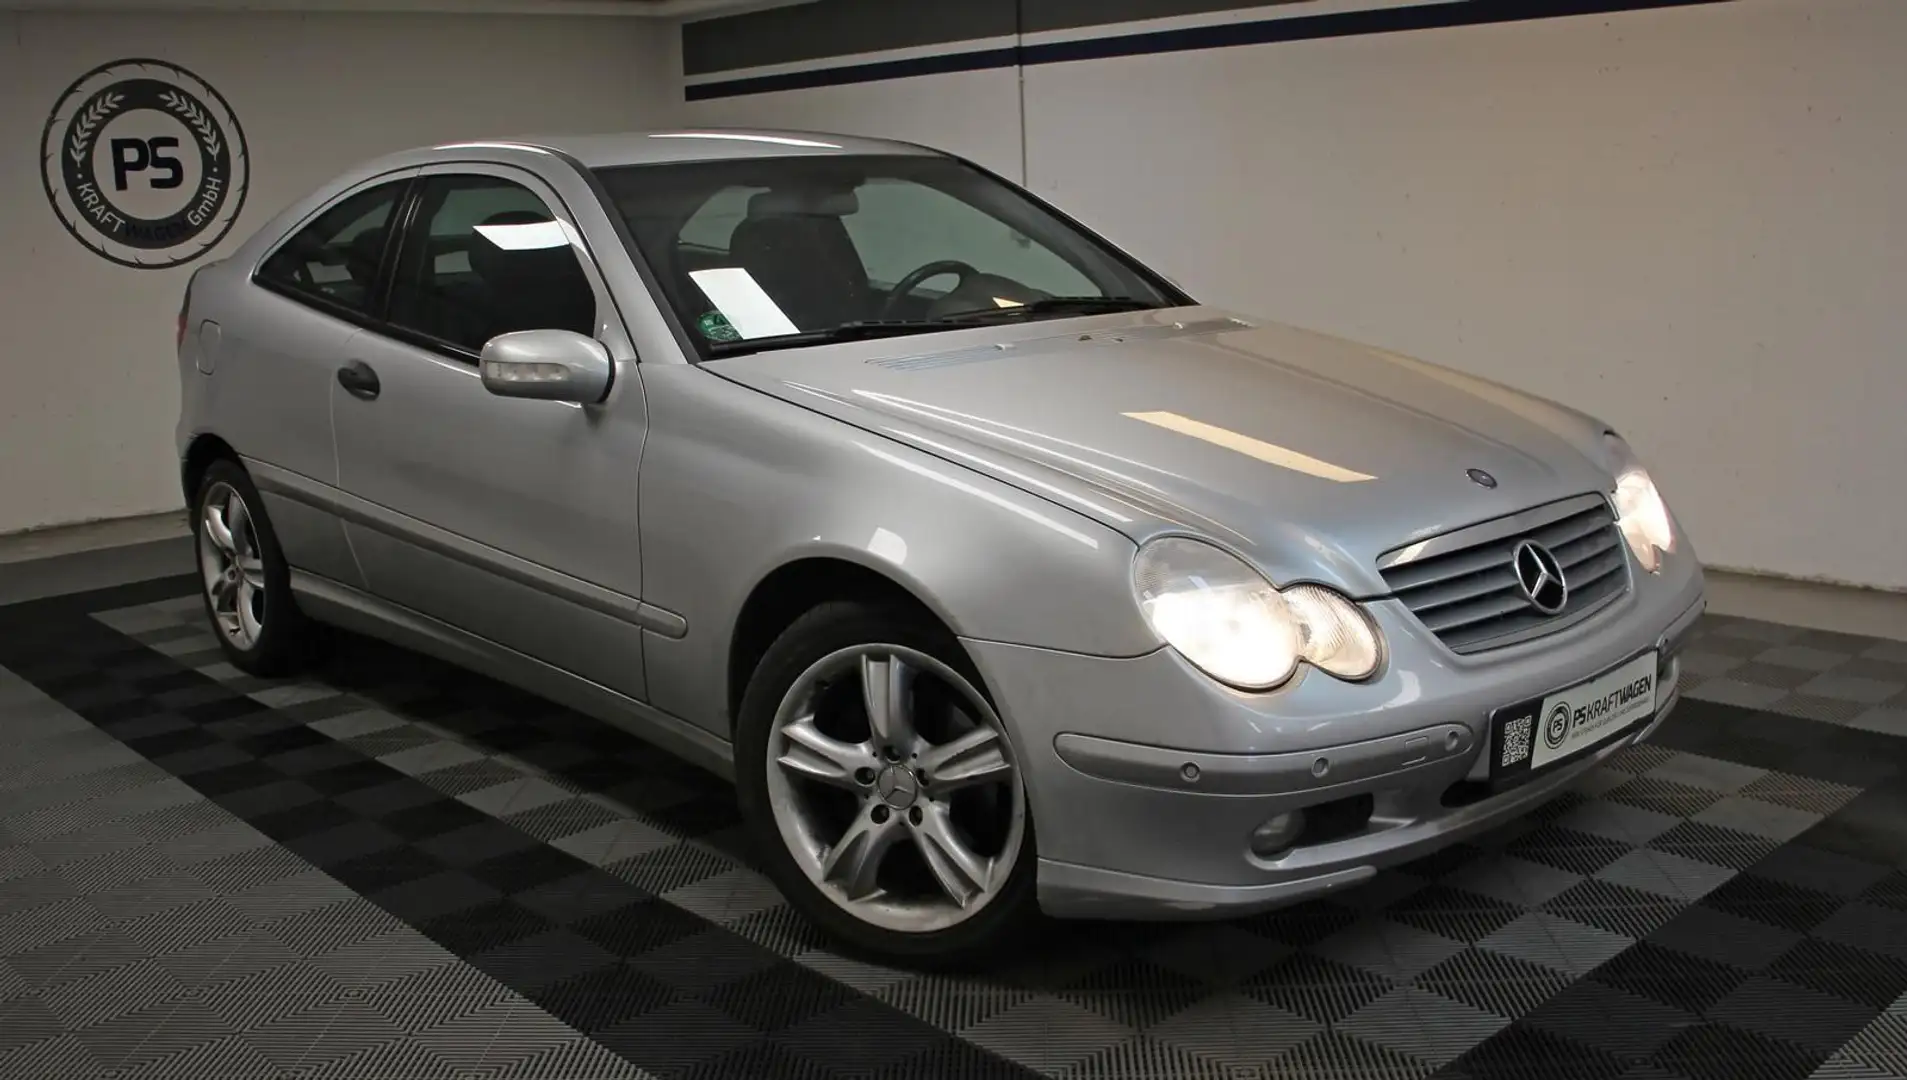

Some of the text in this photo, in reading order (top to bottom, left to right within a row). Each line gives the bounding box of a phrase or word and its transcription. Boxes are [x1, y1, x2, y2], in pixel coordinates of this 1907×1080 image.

[110, 136, 184, 191] PS
[187, 177, 222, 227] GmbH
[1553, 718, 1564, 733] PS
